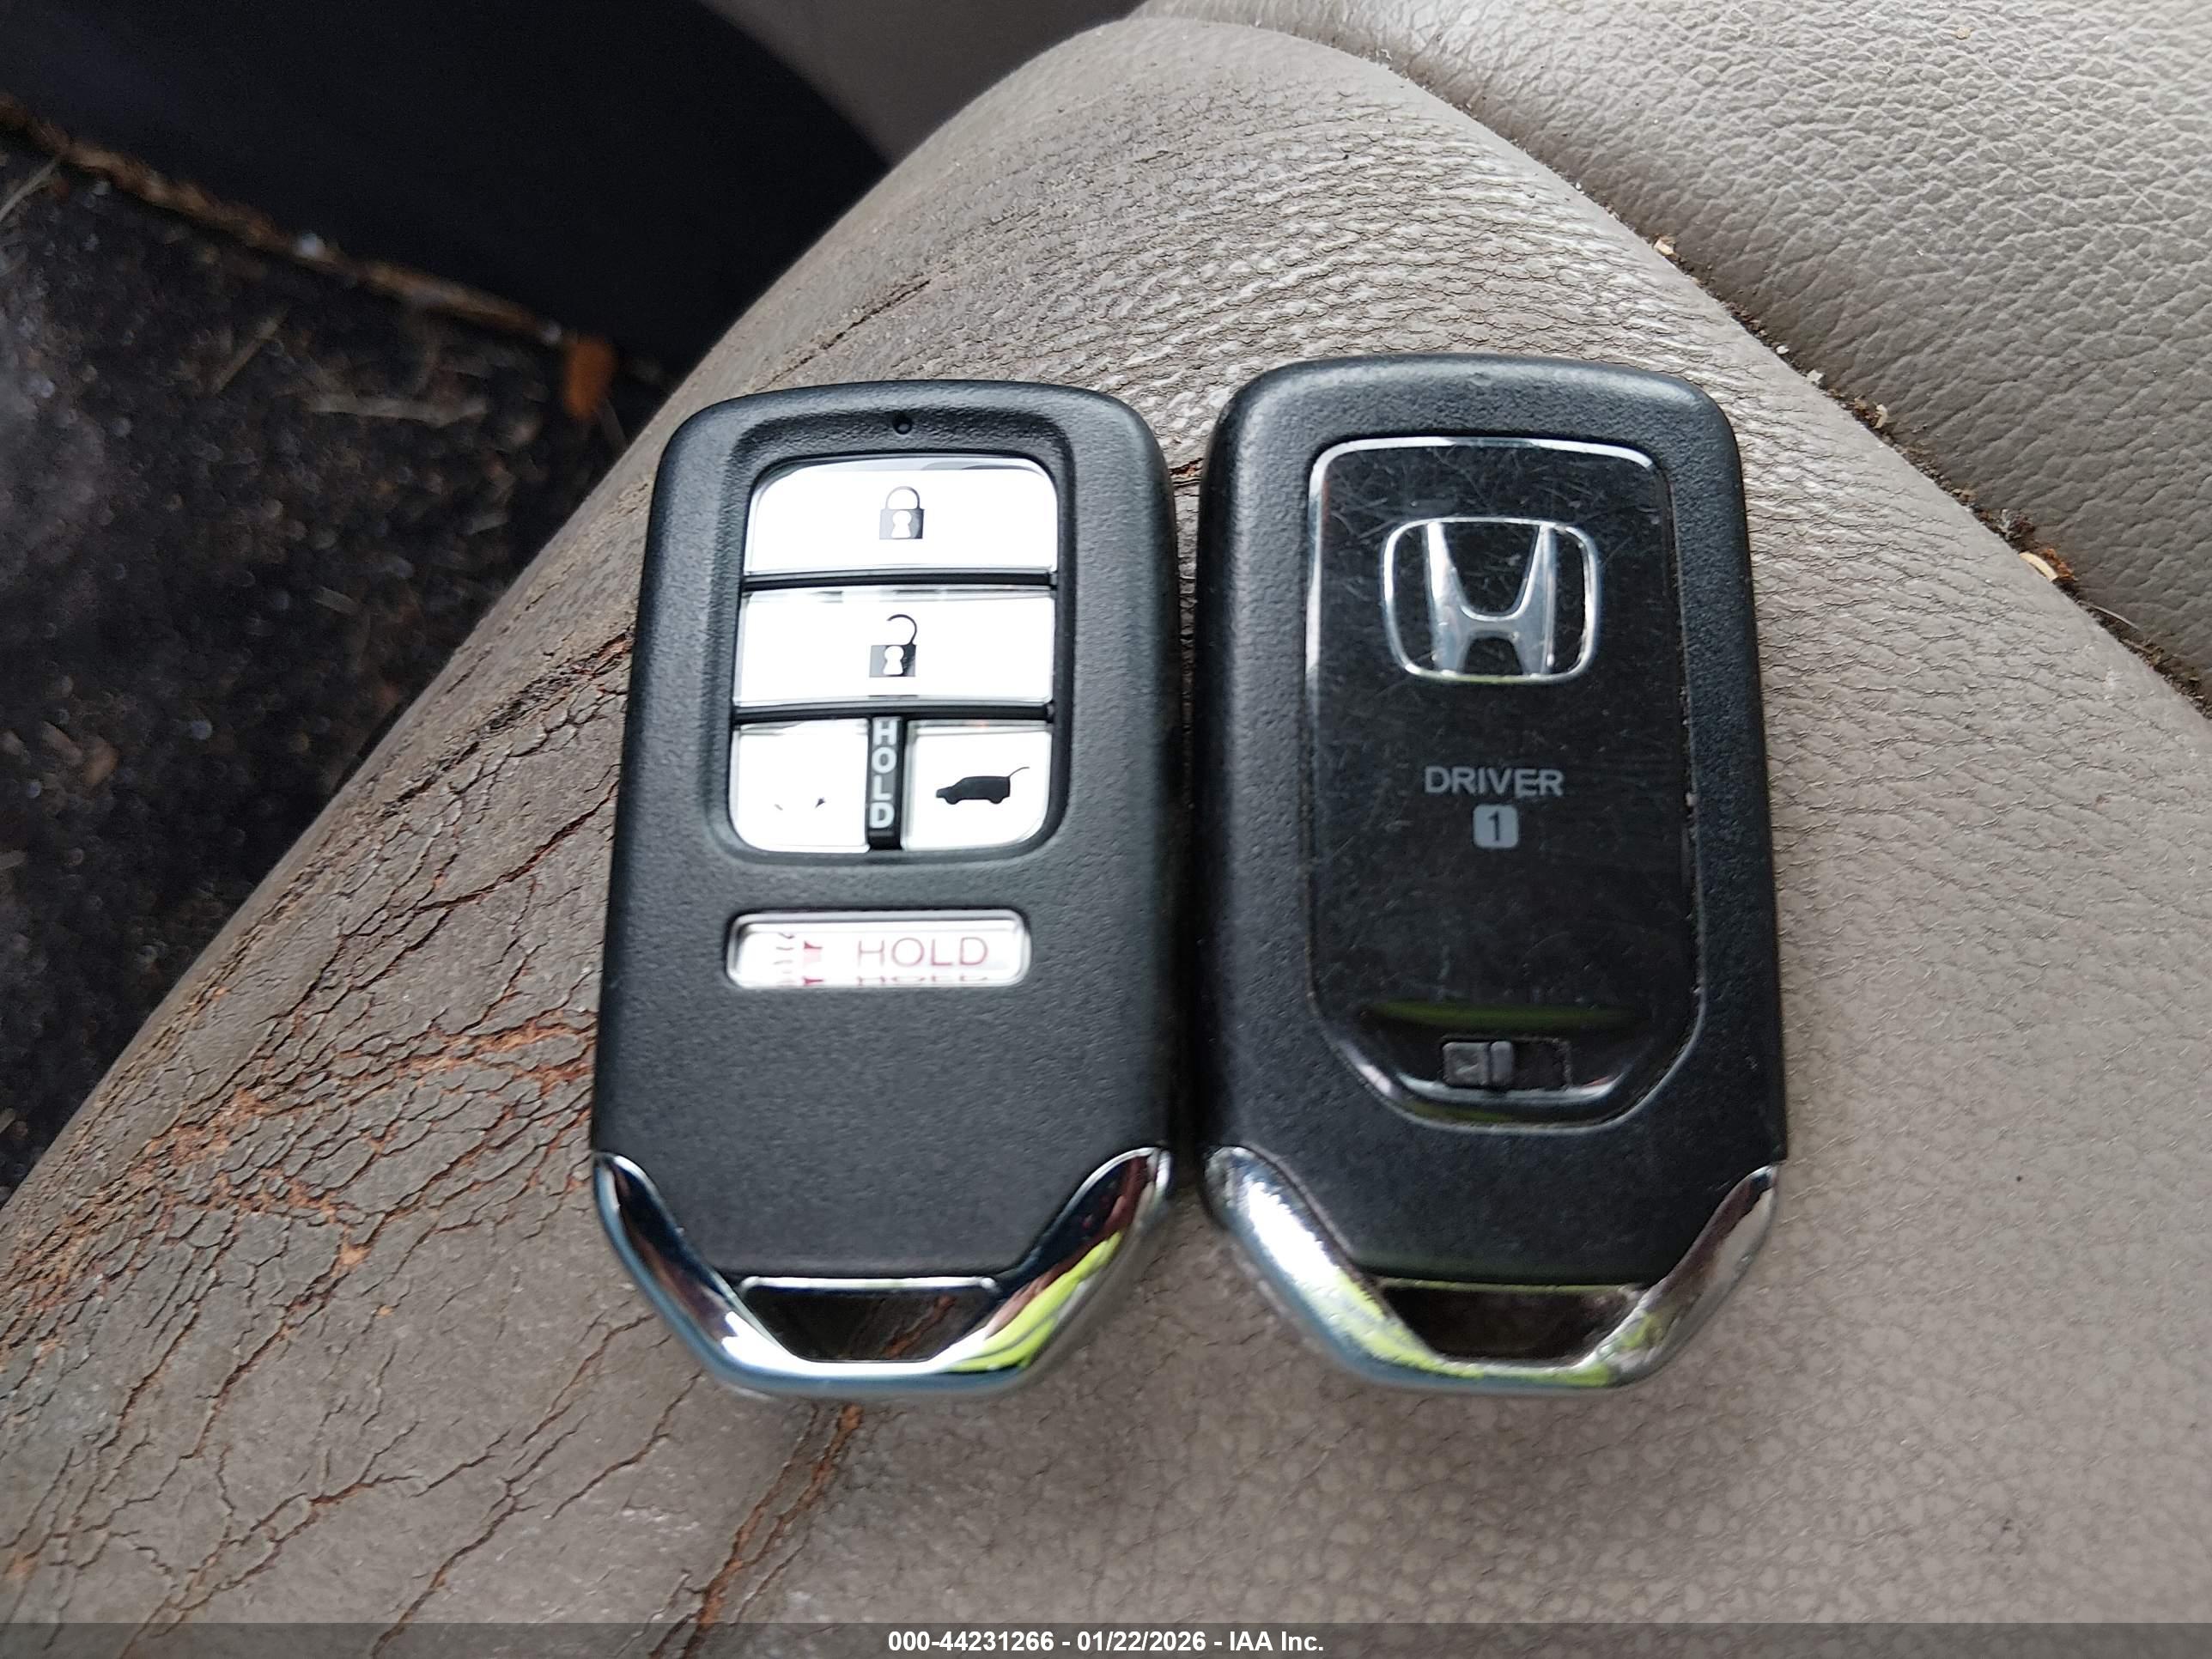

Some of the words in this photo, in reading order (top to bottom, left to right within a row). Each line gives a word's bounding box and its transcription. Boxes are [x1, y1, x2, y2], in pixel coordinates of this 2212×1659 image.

[869, 719, 897, 829] HOLD
[1424, 766, 1565, 797] DRIVER
[858, 936, 988, 967] HOLD
